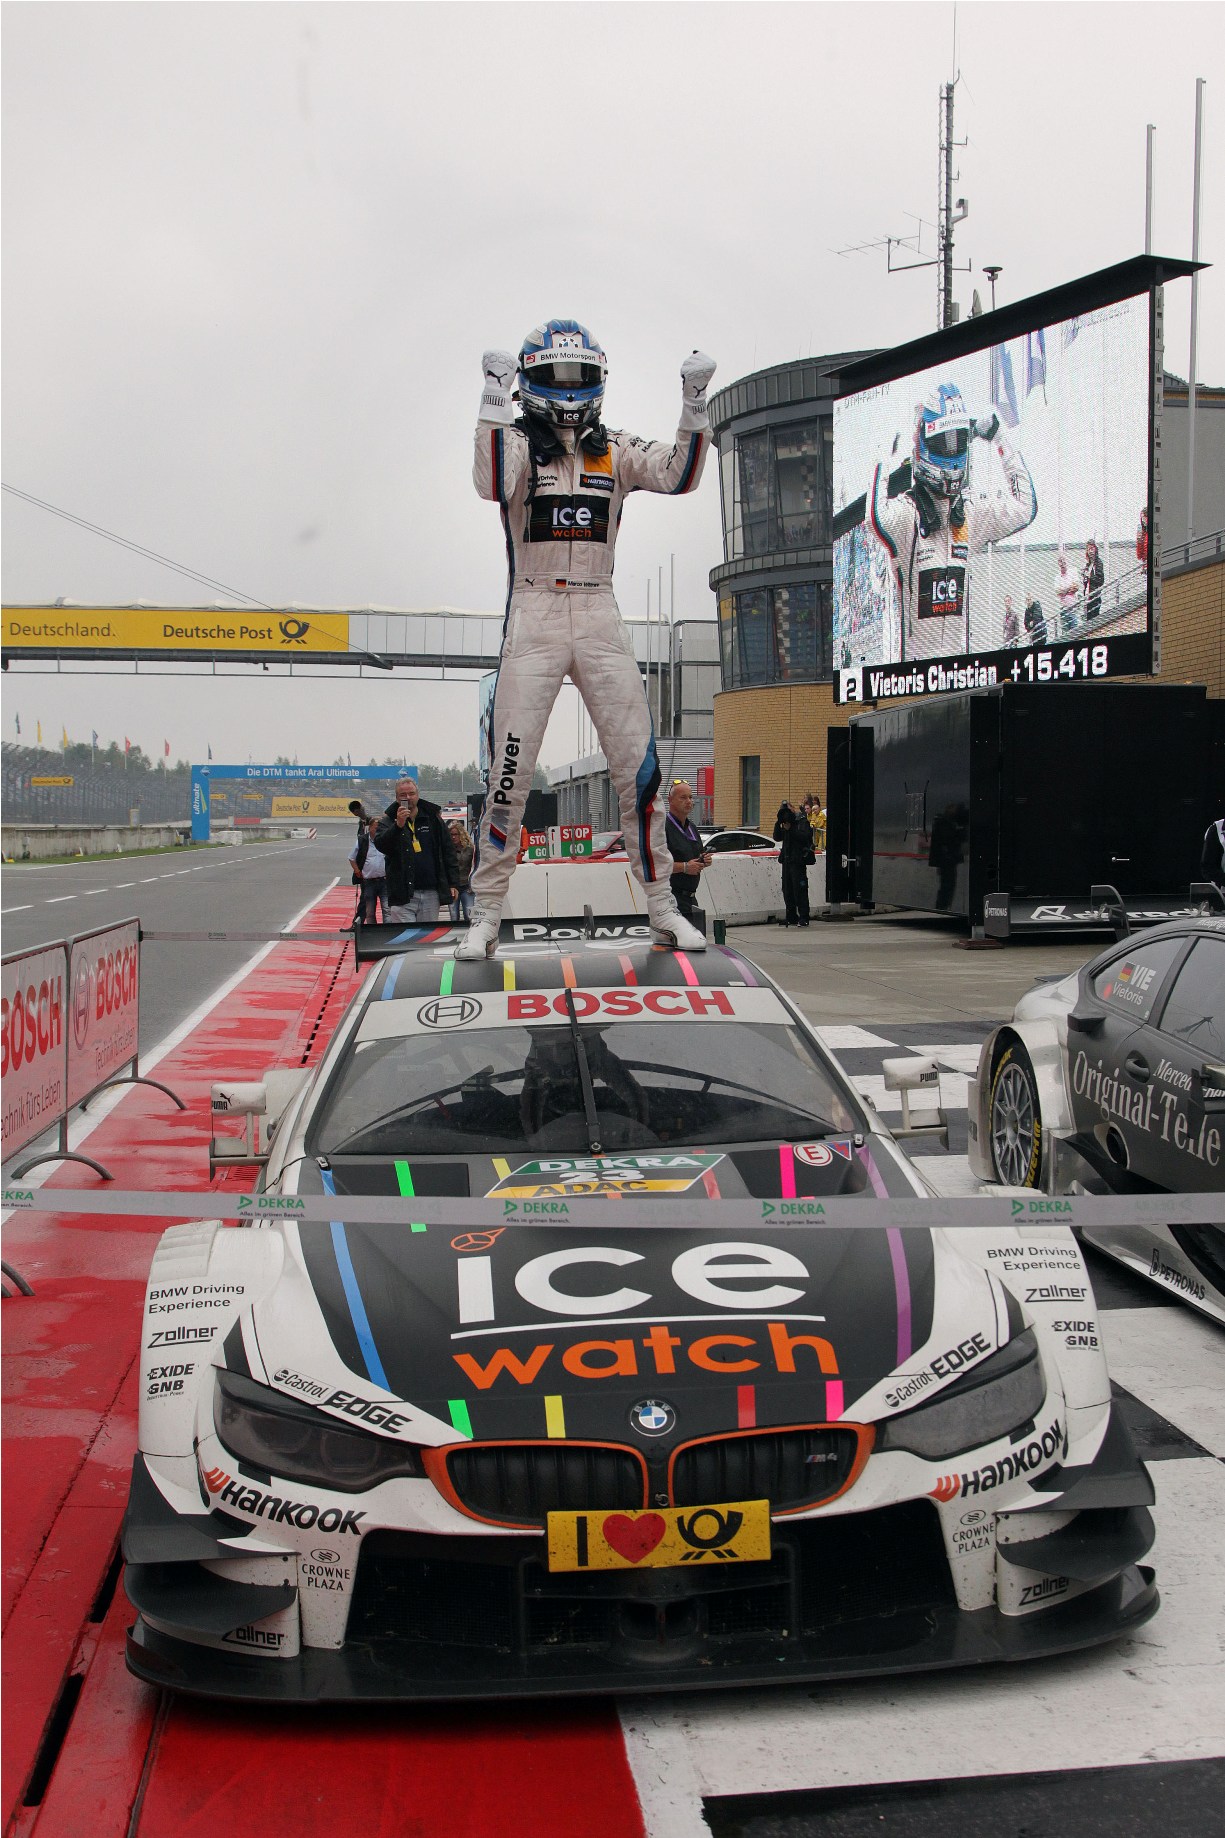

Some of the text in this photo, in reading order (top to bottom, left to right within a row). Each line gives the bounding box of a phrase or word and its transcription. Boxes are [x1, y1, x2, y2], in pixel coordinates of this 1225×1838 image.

[540, 353, 559, 361] BMW
[552, 528, 592, 538] watch
[10, 622, 273, 640] Deutschland. Deutsche Post
[869, 671, 925, 698] Vietoris
[927, 660, 997, 691] Christian
[1010, 645, 1108, 683] +15.418
[247, 768, 360, 777] Die DTM tankt Aral Ultimate
[494, 732, 521, 805] Power
[529, 835, 546, 845] STO
[562, 827, 590, 840] STOP
[513, 924, 650, 941] Powe
[96, 943, 137, 1021] BOSCH
[1130, 964, 1157, 991] VIE
[1113, 981, 1144, 1006] Vietoris
[508, 990, 736, 1020] BOSCH
[1073, 1050, 1222, 1167] Original-Tele
[803, 1146, 823, 1160] E
[539, 1156, 703, 1172] DEKRA
[559, 1169, 645, 1184] 23
[1, 1191, 34, 1200] EKRA
[532, 1181, 649, 1197] ADAC
[258, 1199, 305, 1209] DEKRA
[523, 1203, 570, 1214] DEKRA
[781, 1203, 826, 1215] DEKRA
[1029, 1201, 1072, 1213] DEKRA
[987, 1246, 1077, 1259] BMW Driving
[1003, 1259, 1081, 1272] Experience
[456, 1241, 811, 1324] ice
[1159, 1262, 1206, 1301] PETRONAS
[150, 1283, 245, 1300] BMW Driving
[148, 1299, 231, 1315] Experience
[1051, 1321, 1095, 1333] EXIDE
[1065, 1335, 1098, 1347] GNB
[452, 1323, 840, 1390] watch
[147, 1363, 195, 1380] EXIDE
[895, 1332, 991, 1401] Castrol EDGE
[147, 1379, 184, 1395] GNB
[284, 1374, 414, 1434] Castrol EDGE
[633, 1400, 671, 1413] BMW
[952, 1521, 995, 1543] CROWNE
[576, 1516, 589, 1567] I
[958, 1536, 991, 1554] PLAZA
[301, 1563, 351, 1580] CROWNE
[307, 1576, 344, 1591] PLAZA
